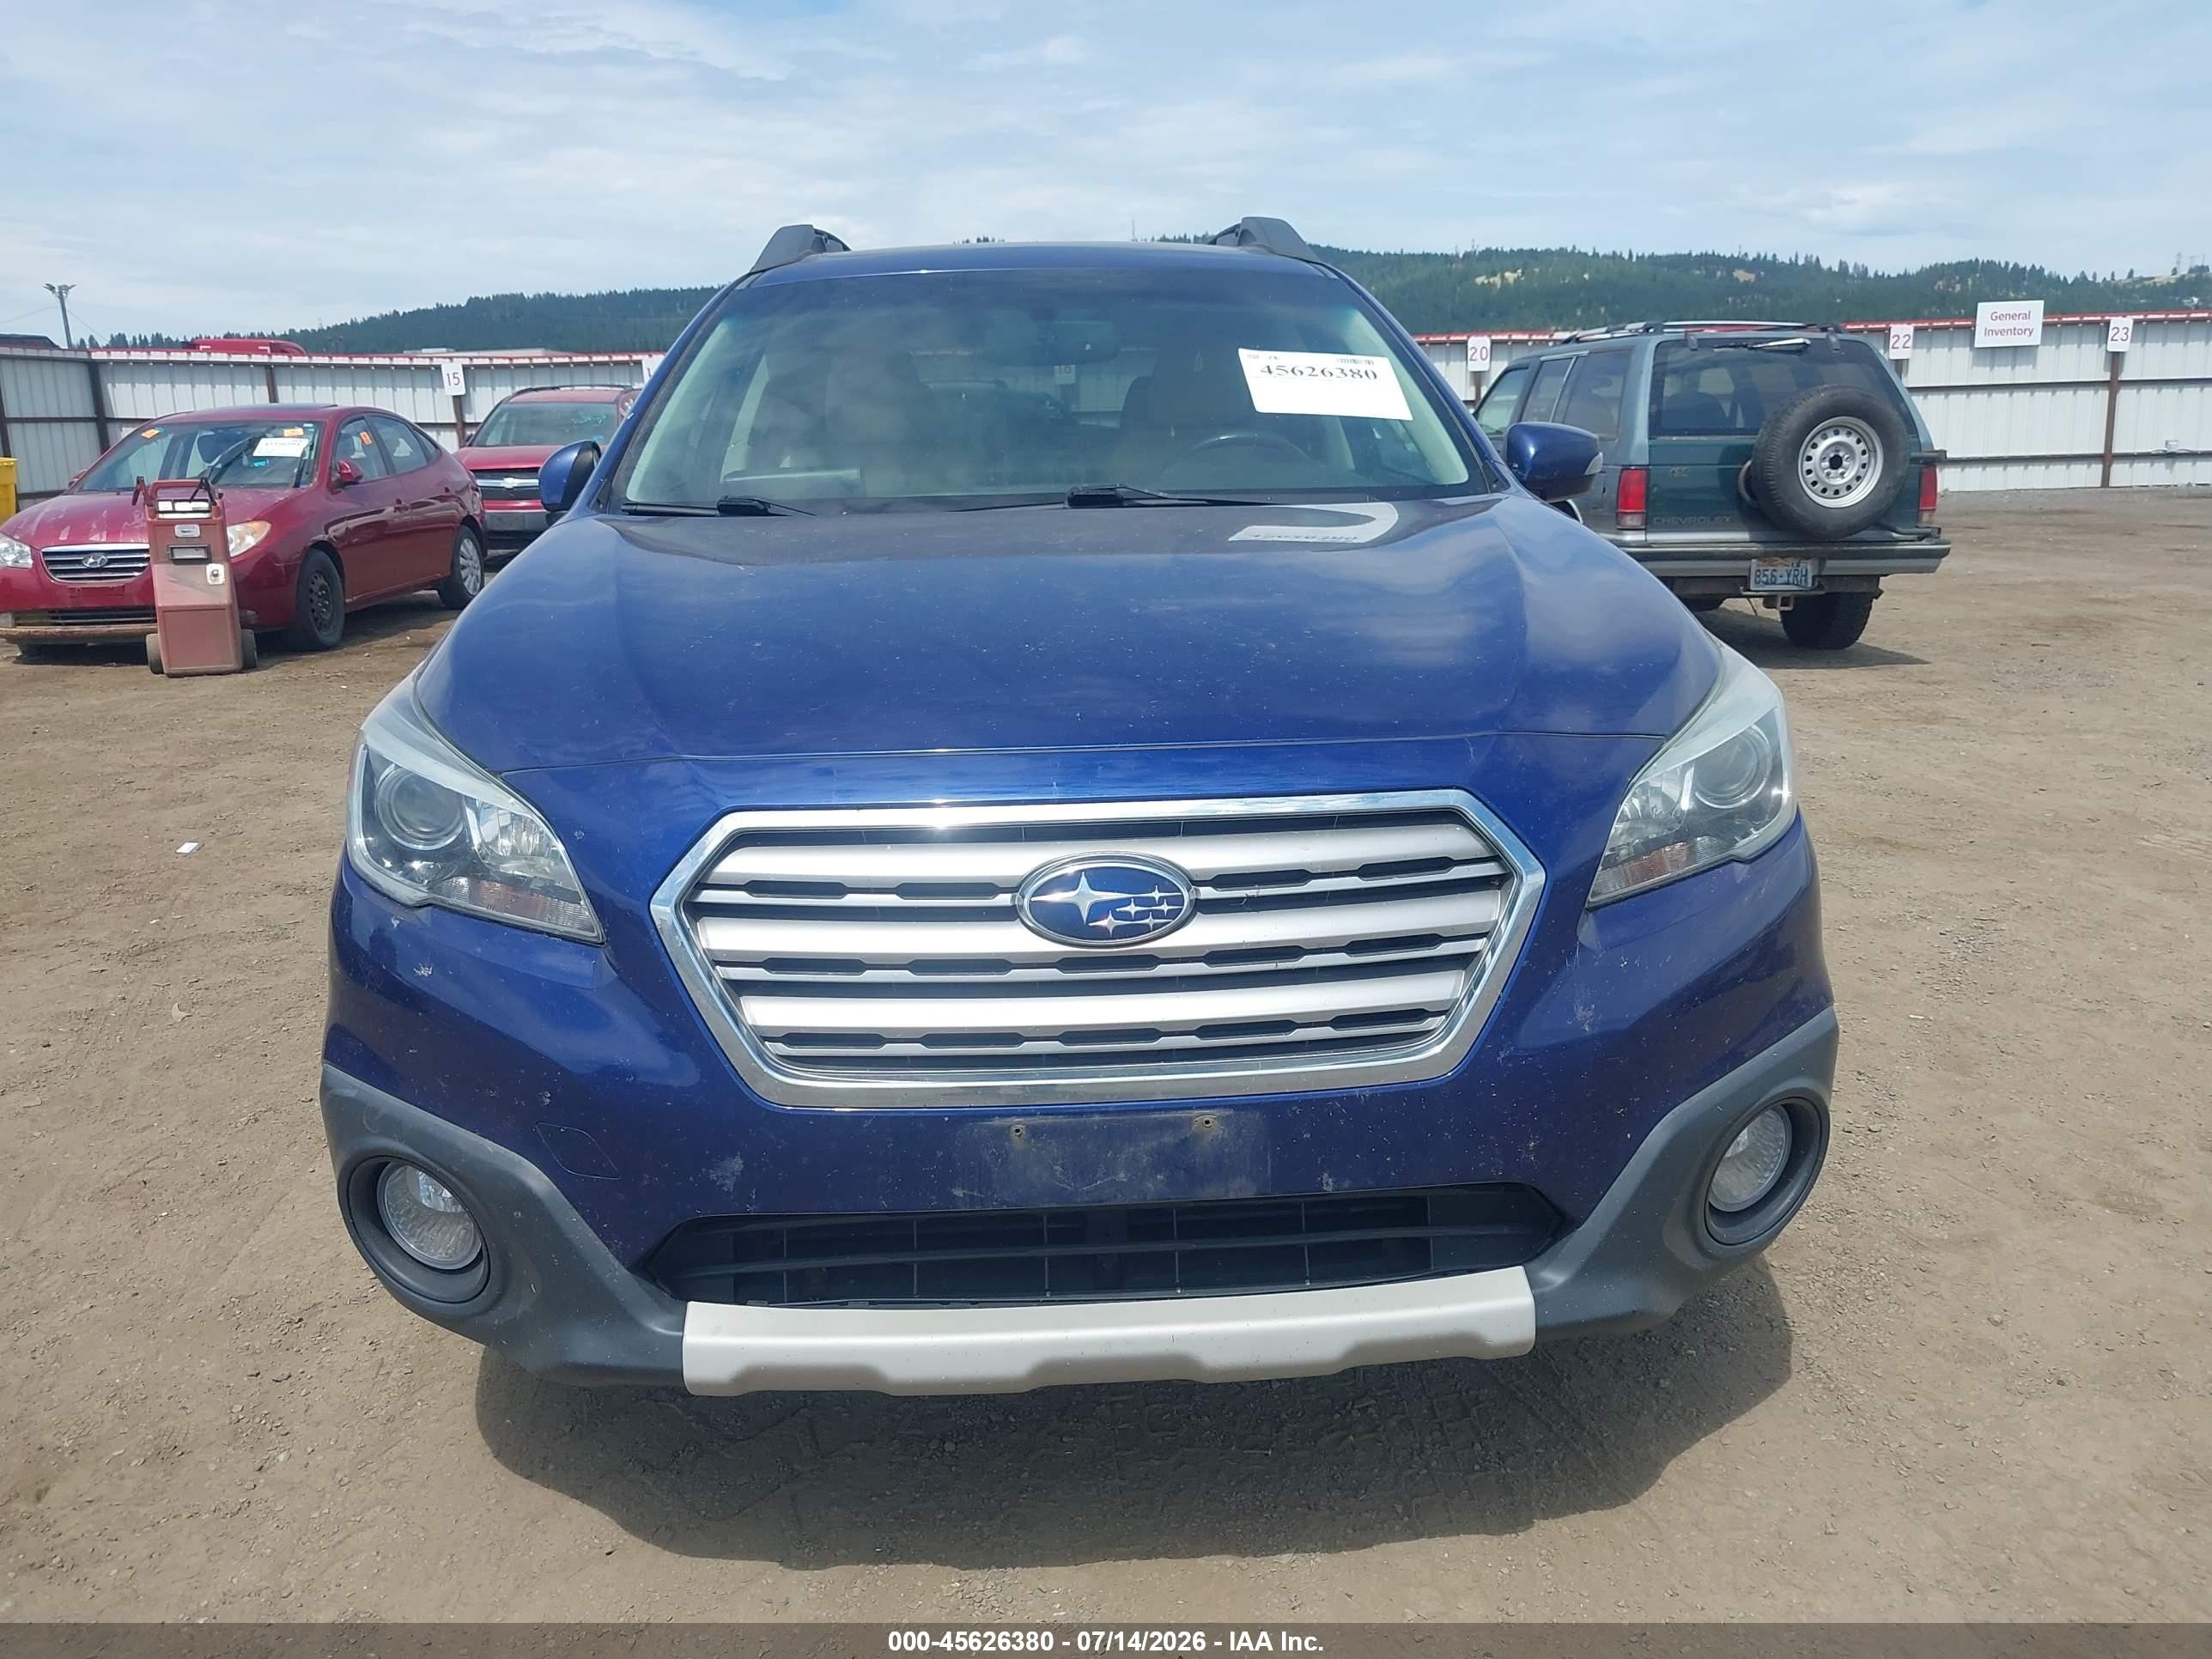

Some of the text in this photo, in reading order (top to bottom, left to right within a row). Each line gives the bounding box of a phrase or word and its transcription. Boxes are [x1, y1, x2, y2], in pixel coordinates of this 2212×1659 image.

[1990, 311, 2031, 322] General
[1984, 326, 2034, 337] Inventory
[2110, 326, 2130, 342] 23
[1891, 334, 1911, 349] 22
[1469, 346, 1488, 362] 20
[446, 372, 461, 386] 15
[1260, 364, 1378, 380] 45626380
[1652, 515, 1732, 525] CHEVROLET
